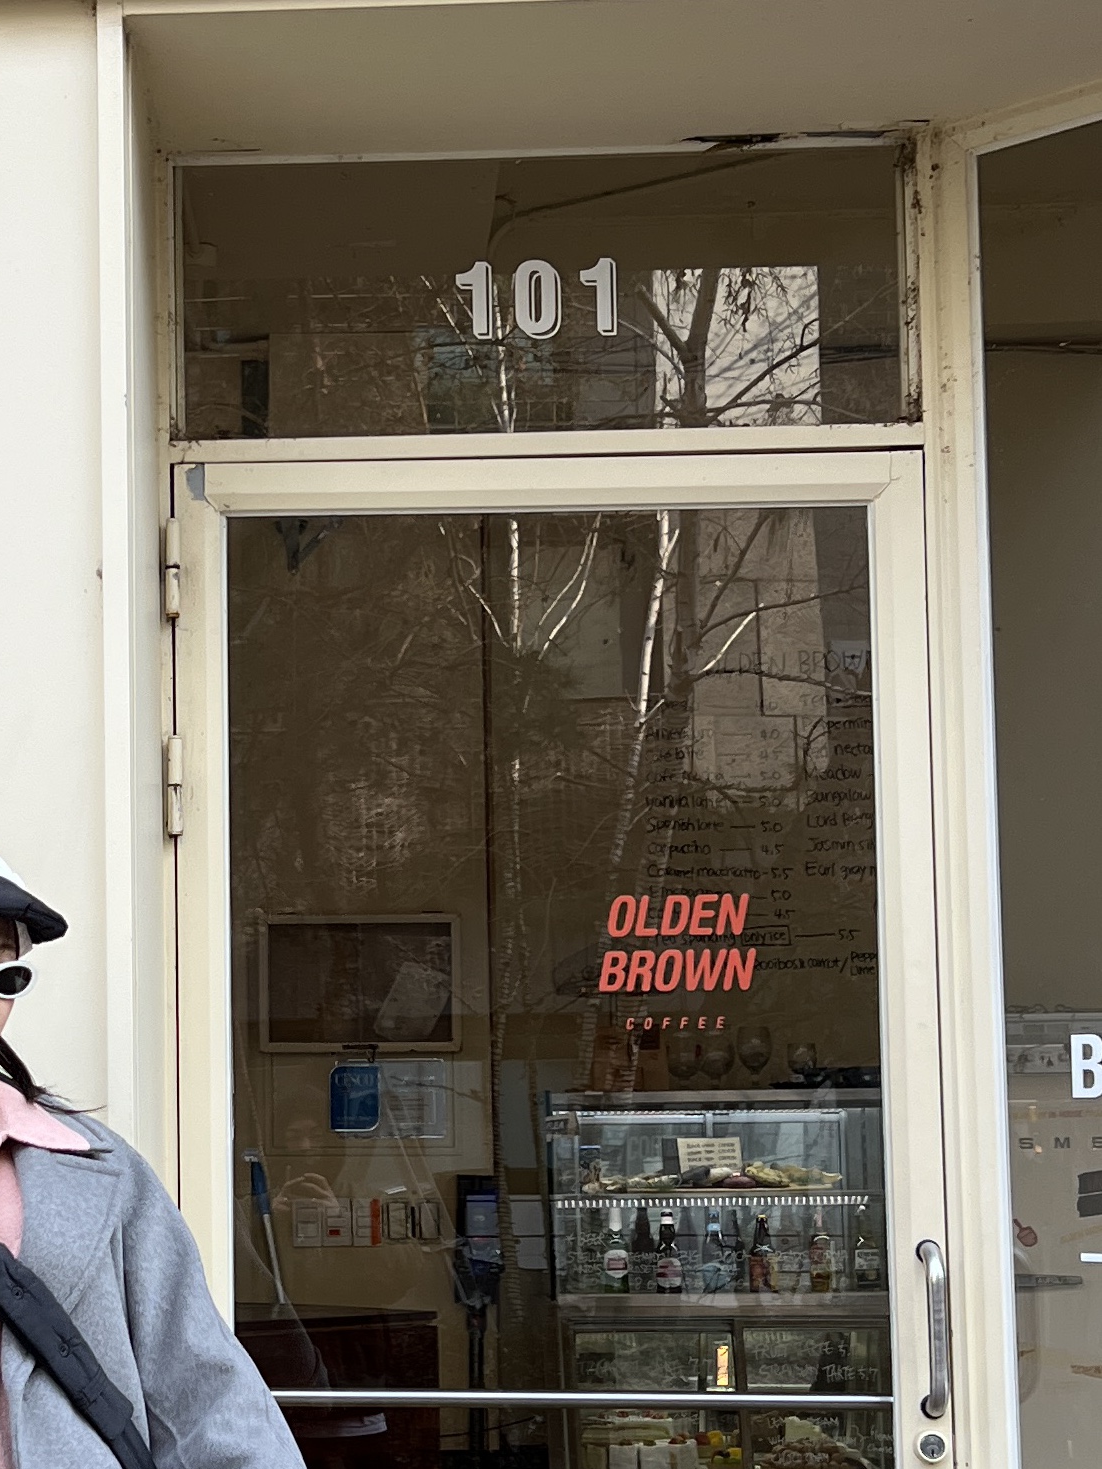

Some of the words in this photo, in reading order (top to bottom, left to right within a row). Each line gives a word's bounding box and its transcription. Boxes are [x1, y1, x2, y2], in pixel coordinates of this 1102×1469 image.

[455, 258, 619, 341] 101
[607, 892, 750, 938] OLDEN
[598, 947, 757, 993] BROWN
[625, 1016, 728, 1031] COFFEE
[1070, 1033, 1102, 1099] B
